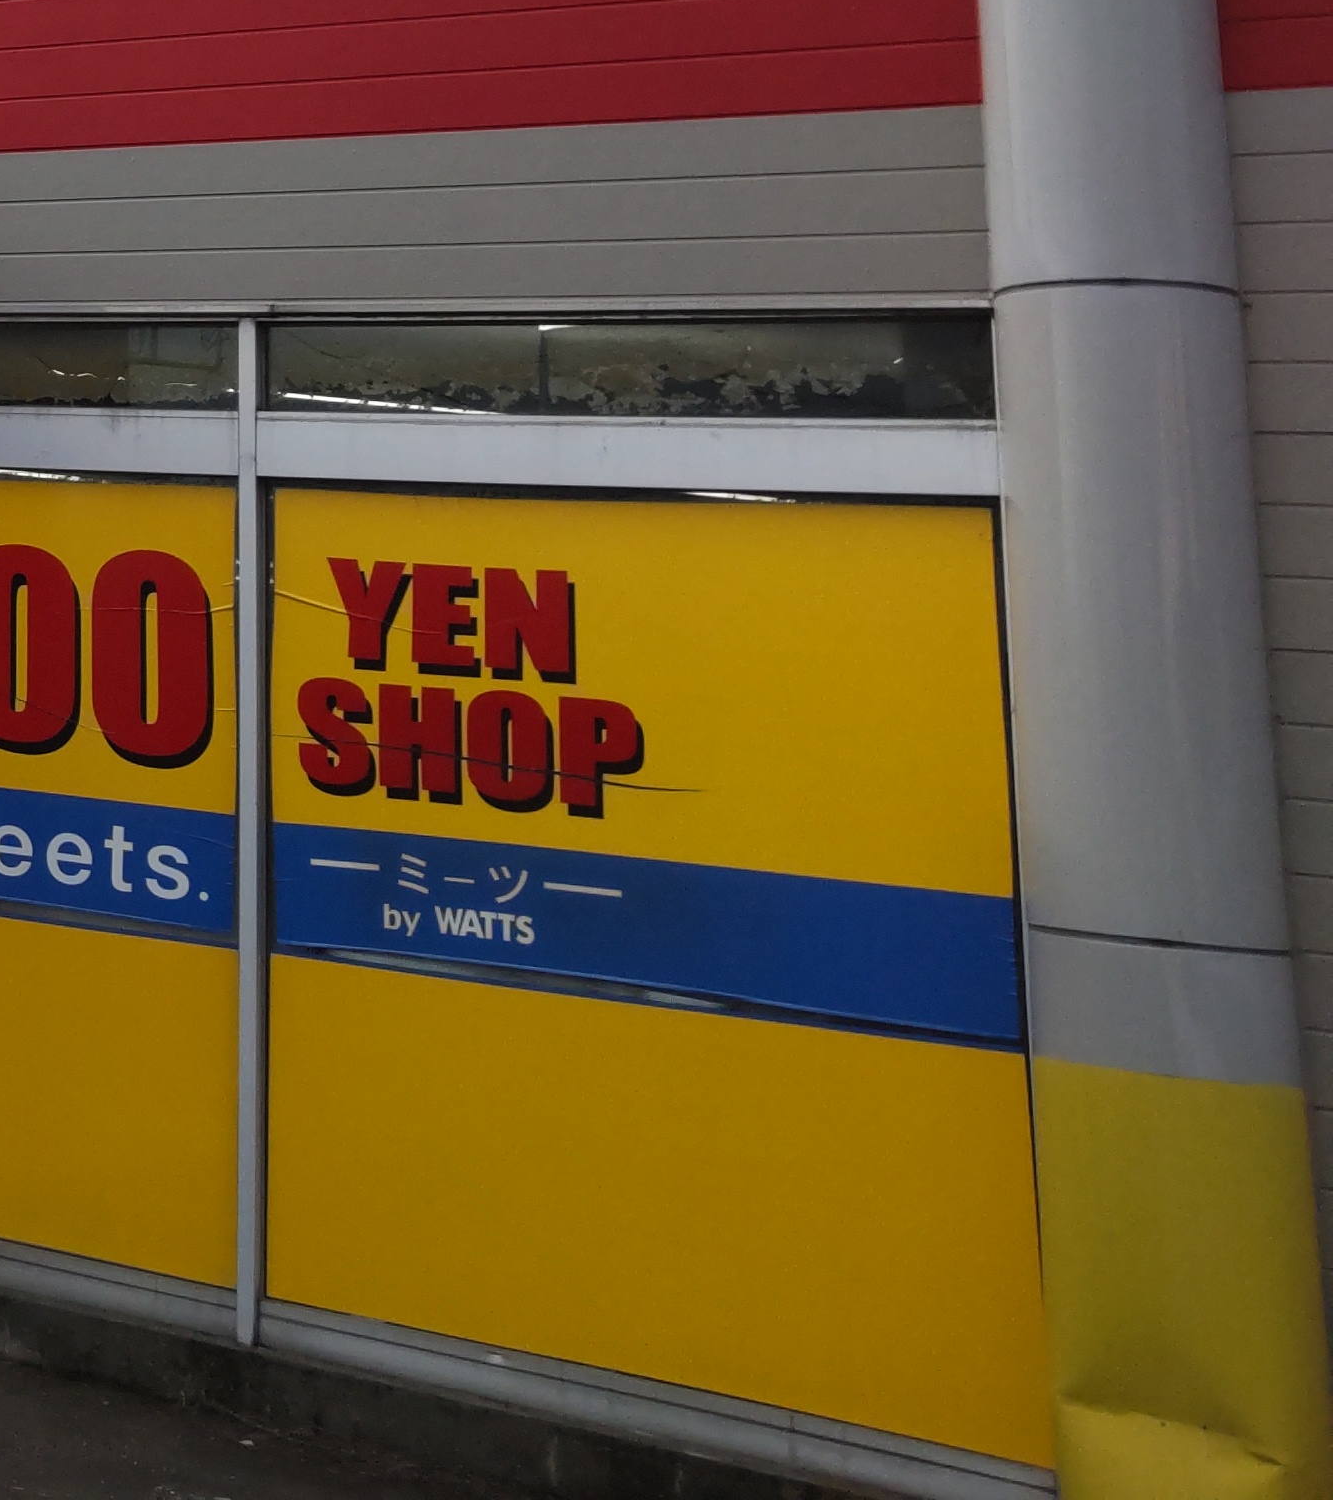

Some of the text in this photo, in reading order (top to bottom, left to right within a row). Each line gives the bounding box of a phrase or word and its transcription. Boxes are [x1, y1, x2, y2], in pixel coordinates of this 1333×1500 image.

[326, 556, 577, 684] YEN
[297, 676, 645, 819] SHOP
[383, 903, 535, 945] by WATTS
